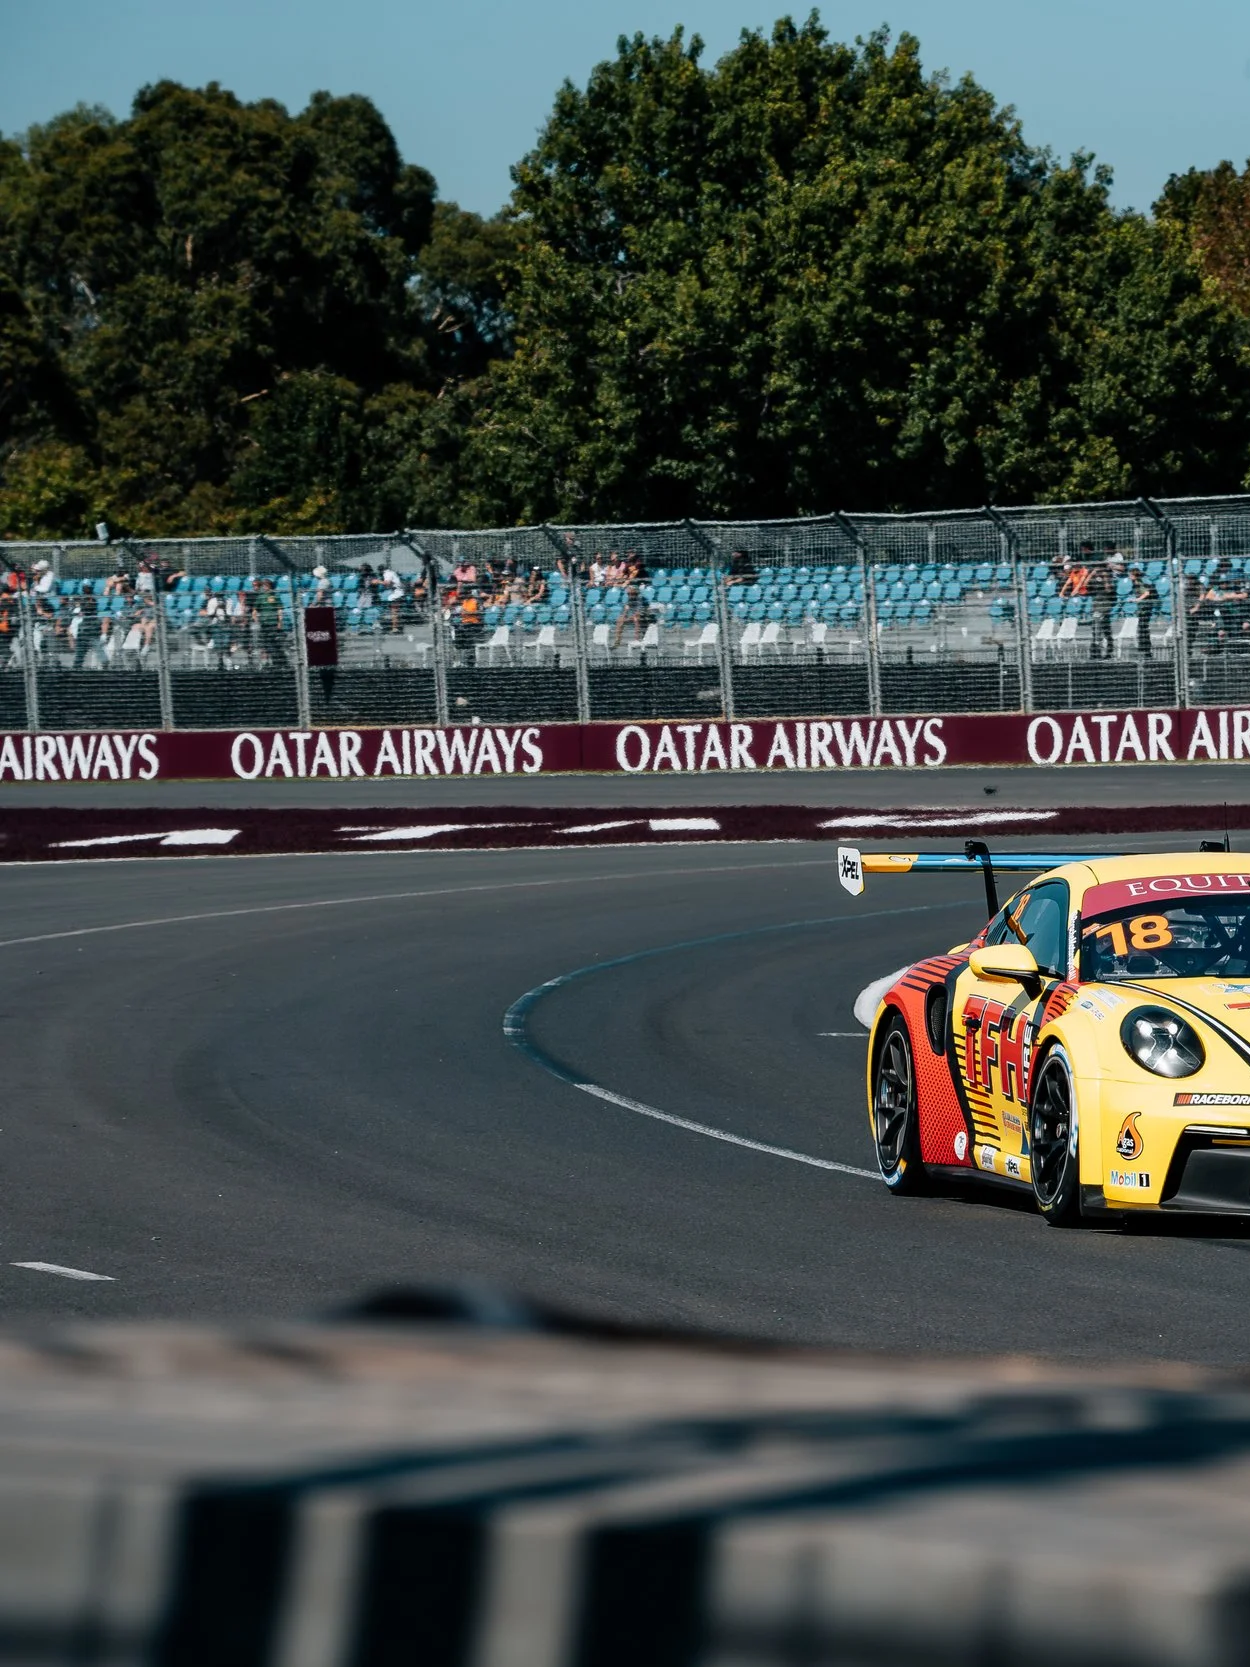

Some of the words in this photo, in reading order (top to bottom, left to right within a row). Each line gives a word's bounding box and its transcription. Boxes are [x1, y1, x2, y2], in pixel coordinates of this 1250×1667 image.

[0, 734, 159, 780] AIRWAYS
[231, 731, 366, 779] QATAR
[373, 728, 544, 776] AIRWAYS
[616, 723, 757, 771] QATAR
[766, 718, 947, 769] AIRWAYS
[1026, 712, 1176, 765] QATAR
[841, 854, 860, 881] XPEL
[1095, 914, 1174, 957] 18
[962, 994, 1030, 1104] TFH
[1110, 1170, 1137, 1186] Mobil
[1140, 1174, 1149, 1187] 1
